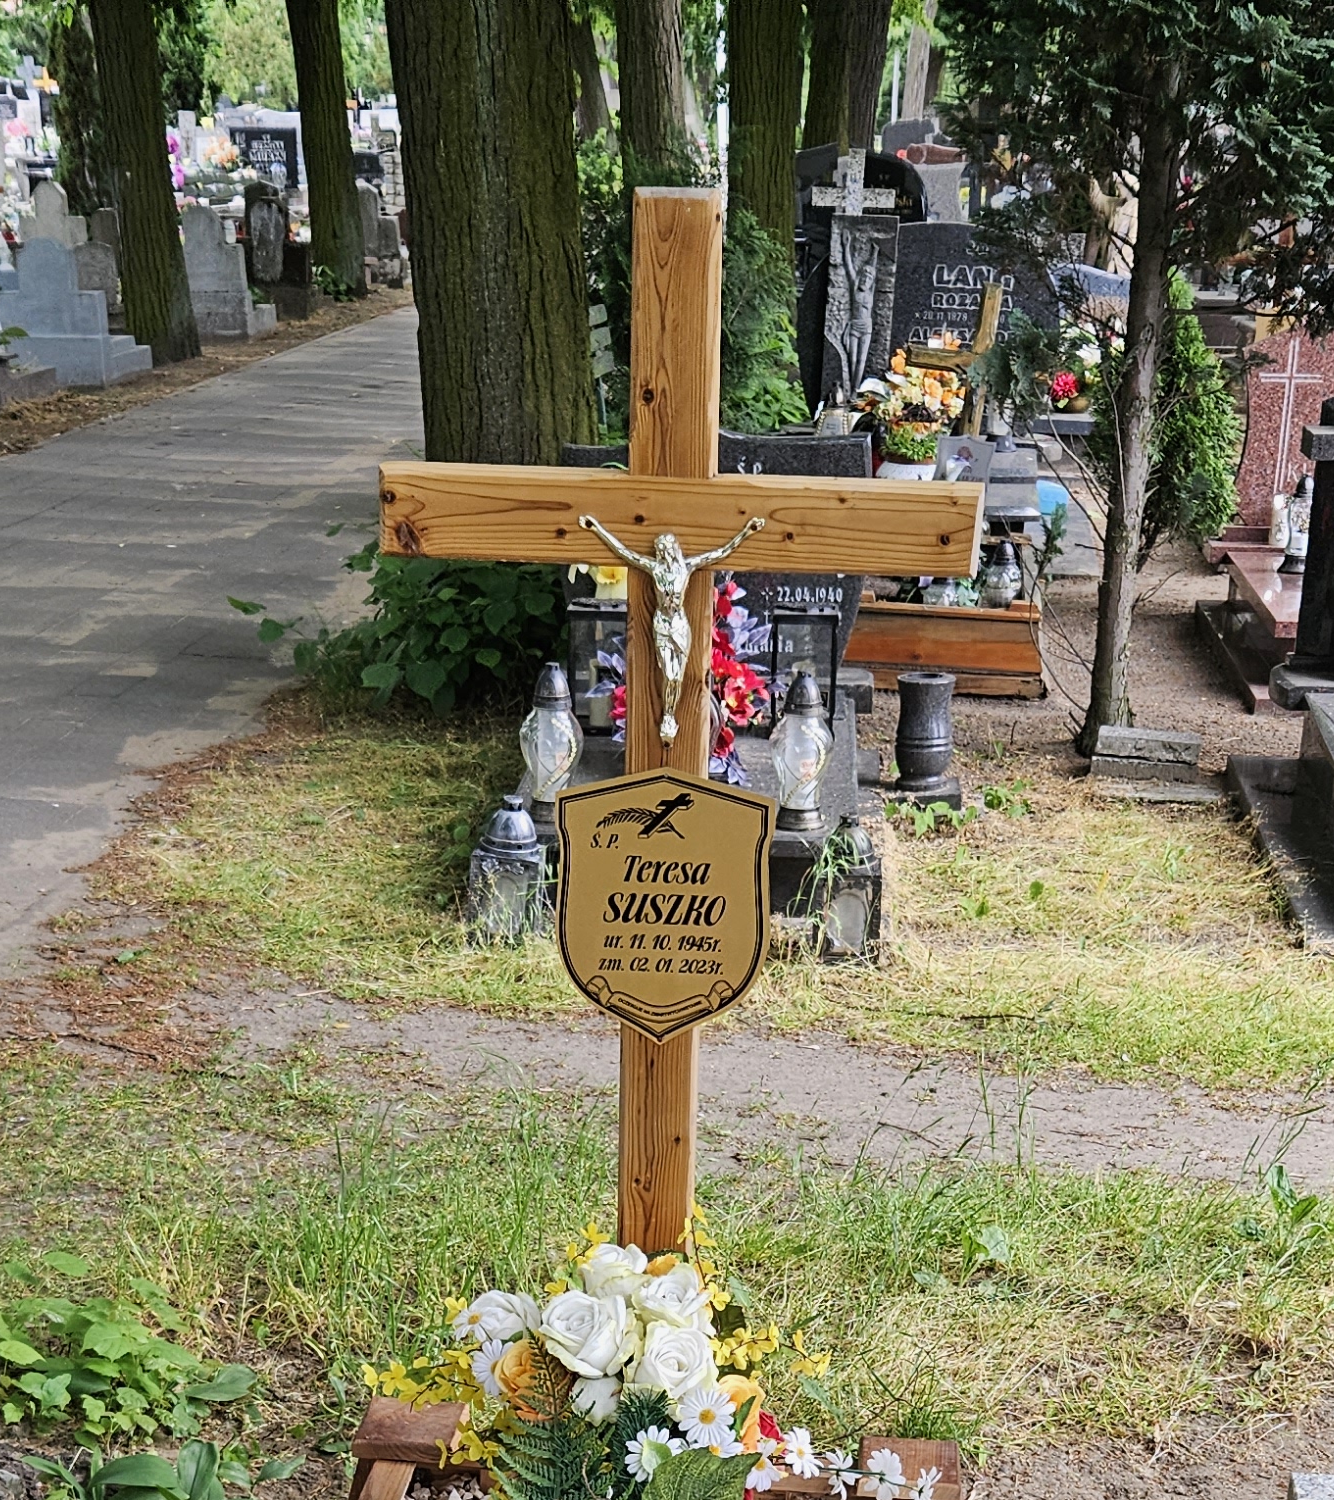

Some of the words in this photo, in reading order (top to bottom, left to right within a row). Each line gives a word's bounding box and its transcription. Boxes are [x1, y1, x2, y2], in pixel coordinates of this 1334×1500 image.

[777, 586, 844, 603] 22.04.1940
[623, 855, 711, 886] Teresa
[603, 892, 727, 927] SUSZKO
[603, 934, 624, 950] ur.
[629, 933, 646, 950] 11.
[652, 934, 672, 951] 10.
[677, 935, 723, 953] 1945r.
[598, 958, 624, 971] zm.
[629, 956, 651, 972] 02.
[655, 957, 674, 973] 01.
[678, 958, 724, 975] 2023r.
